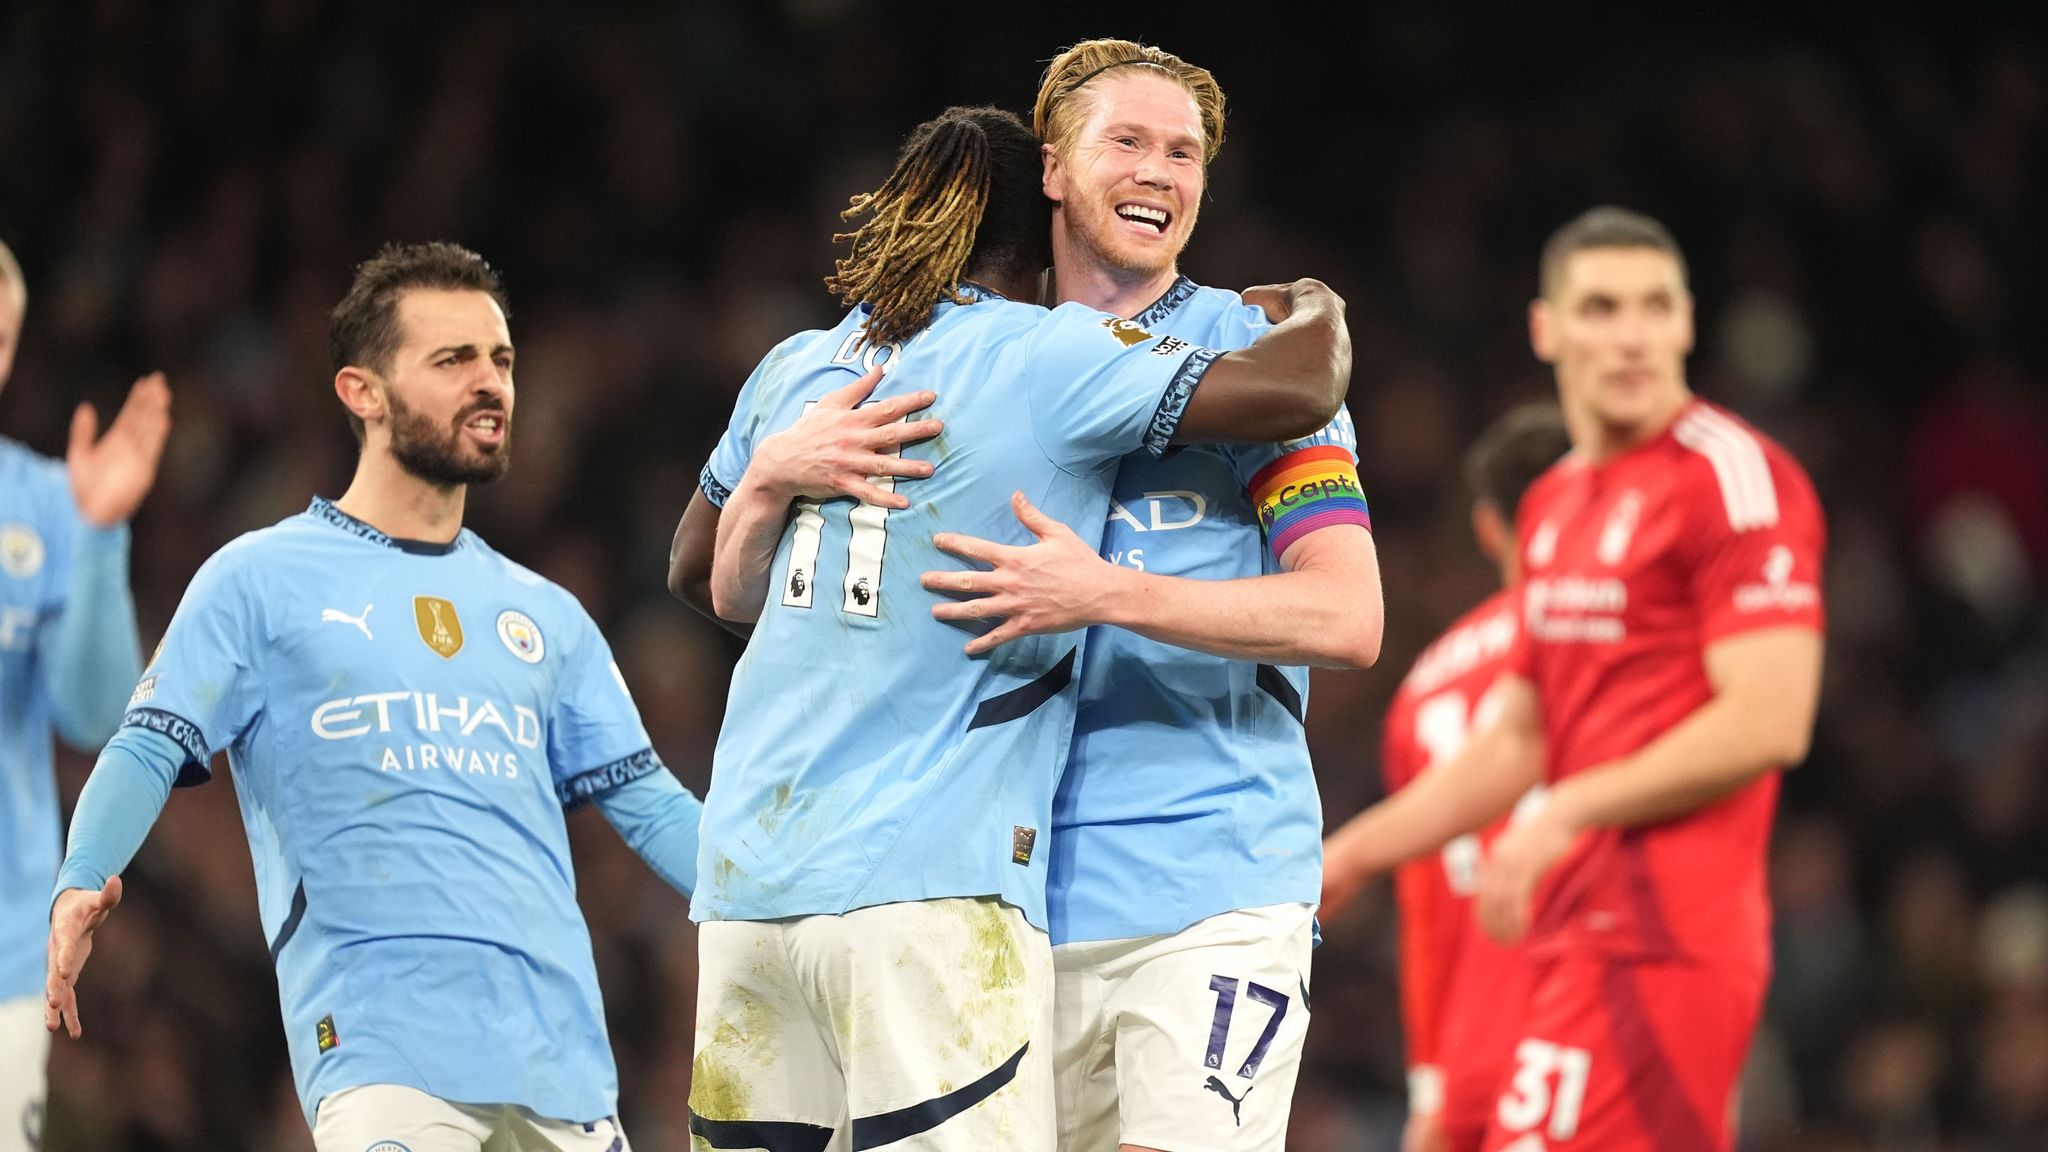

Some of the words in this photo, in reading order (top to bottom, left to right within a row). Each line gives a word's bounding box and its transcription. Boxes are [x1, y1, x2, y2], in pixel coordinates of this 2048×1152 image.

[311, 691, 541, 749] ETIHAD
[381, 743, 518, 779] AIRWAYS
[1204, 974, 1290, 1080] 17
[1496, 1037, 1593, 1141] 31
